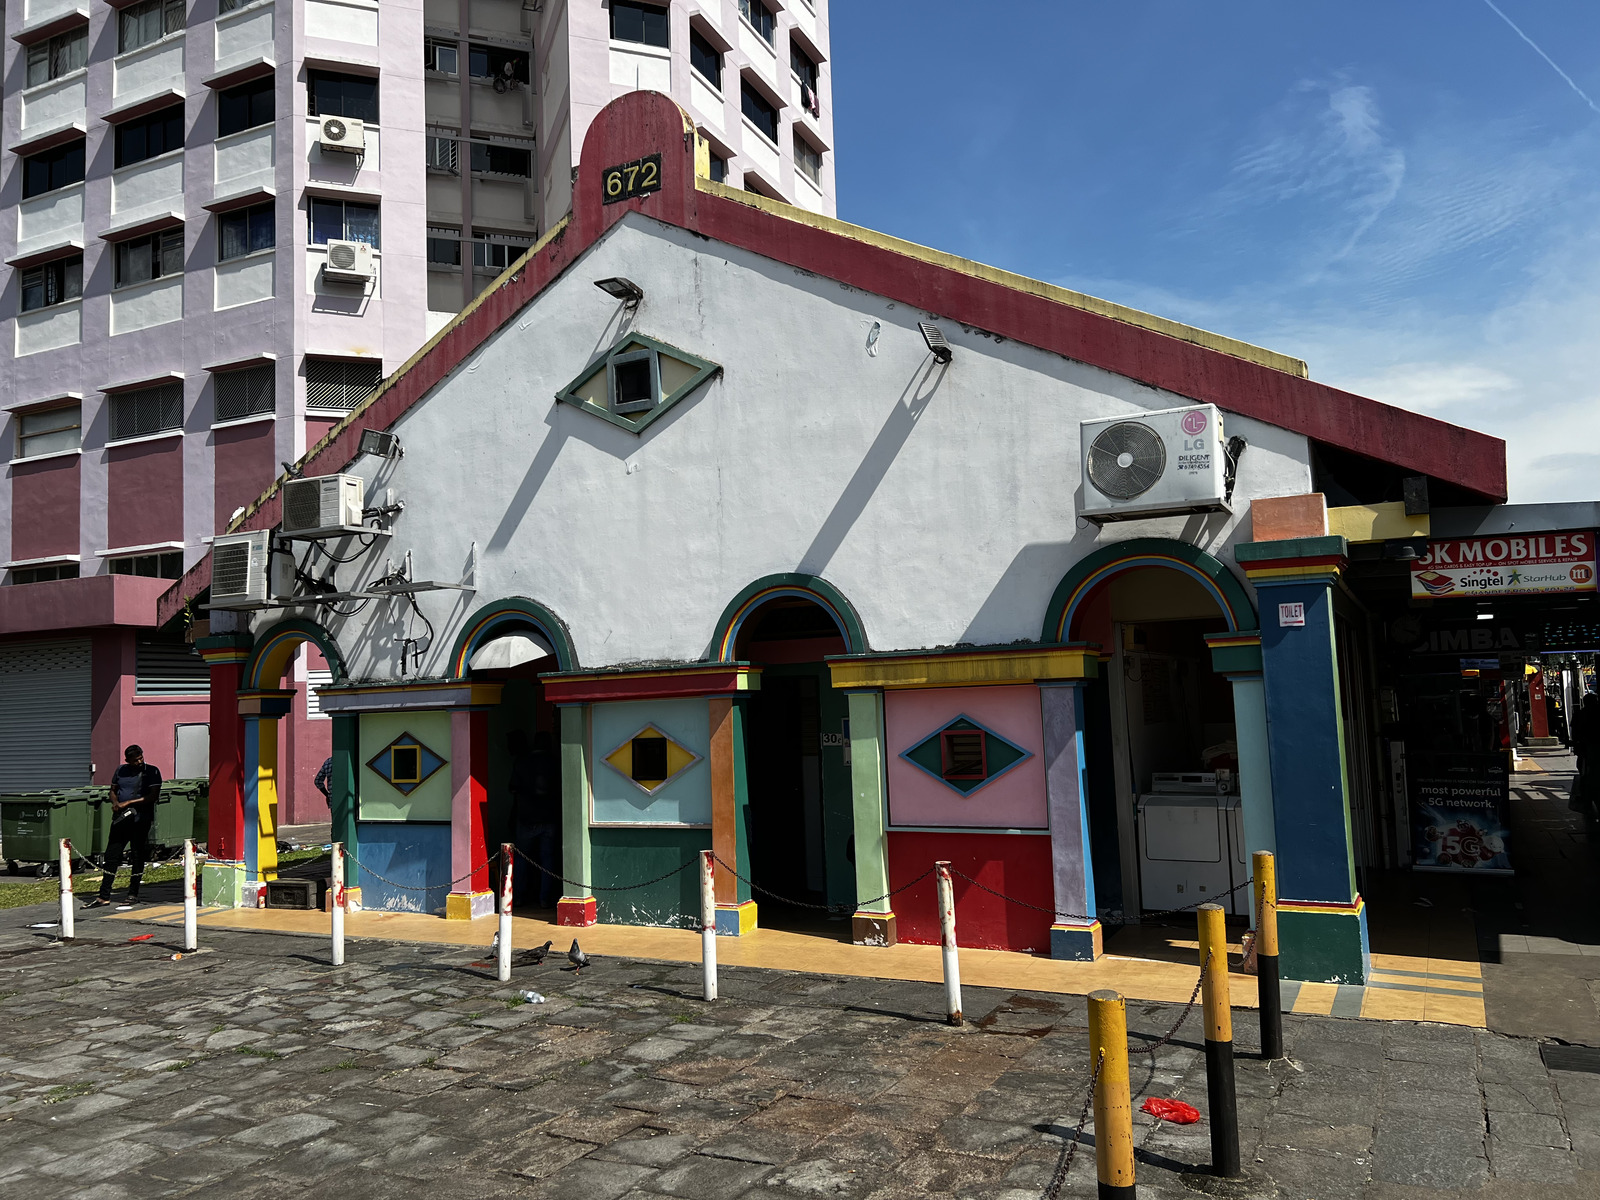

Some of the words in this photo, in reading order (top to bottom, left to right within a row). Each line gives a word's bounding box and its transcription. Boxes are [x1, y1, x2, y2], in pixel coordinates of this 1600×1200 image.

[606, 161, 657, 196] 672
[1184, 438, 1205, 451] LG
[1459, 534, 1588, 562] MOBILES
[1460, 576, 1504, 589] Singtel
[1523, 574, 1567, 583] StarHub
[1280, 604, 1303, 618] TOILET
[1411, 626, 1521, 652] IMBA
[1421, 786, 1449, 795] most
[1451, 787, 1501, 797] powerful
[1428, 797, 1444, 806] 5G
[1446, 799, 1495, 808] network.
[36, 809, 48, 817] 672
[1446, 835, 1480, 857] 5G
